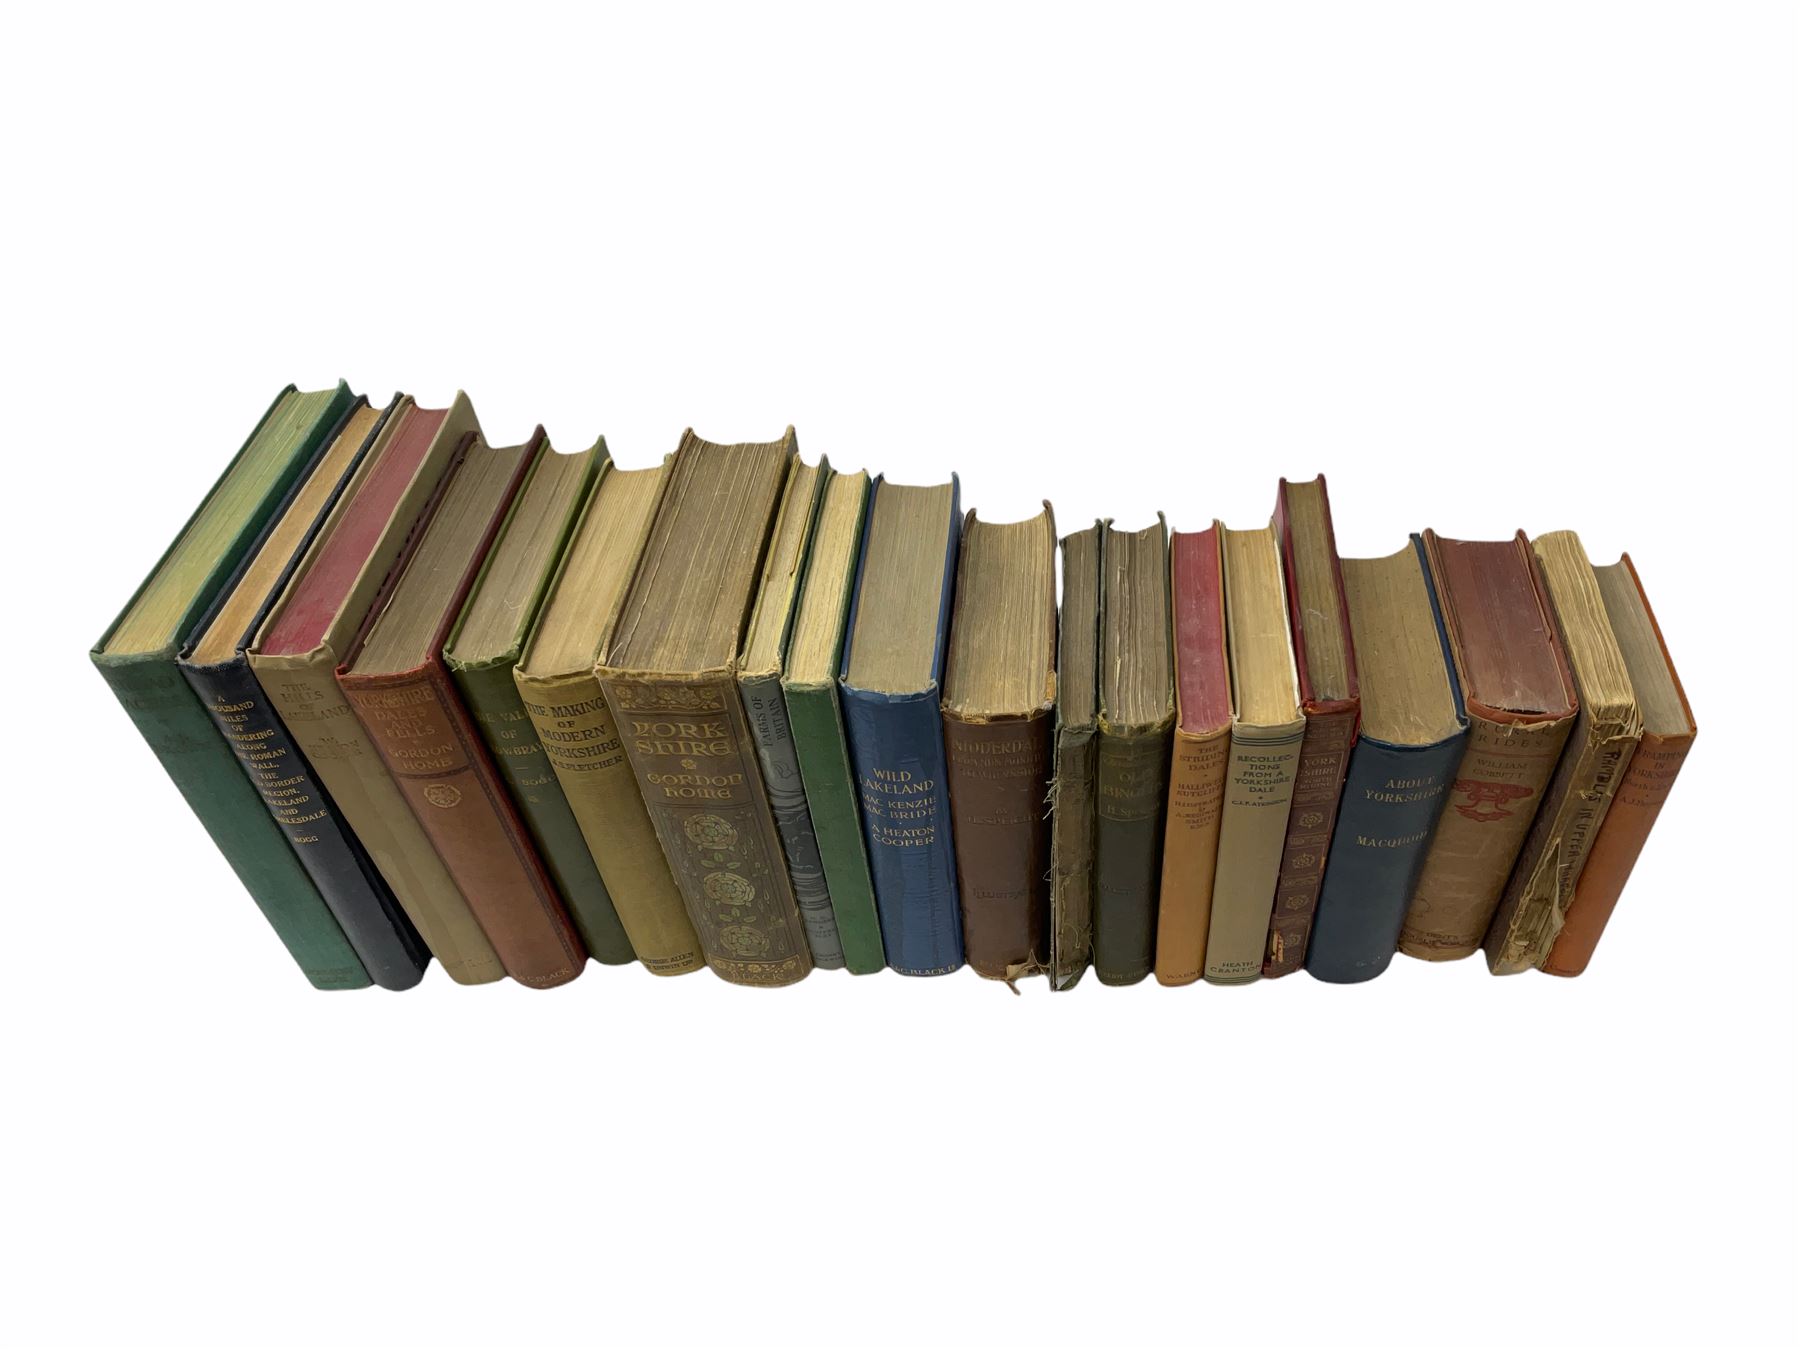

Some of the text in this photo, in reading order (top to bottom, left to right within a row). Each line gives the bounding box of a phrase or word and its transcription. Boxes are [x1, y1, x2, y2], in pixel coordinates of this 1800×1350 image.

[524, 696, 606, 718] THE MAKING
[751, 696, 764, 710] OF
[558, 720, 576, 728] OF
[768, 698, 787, 741] BRITAIN
[500, 730, 518, 740] OF
[540, 725, 607, 743] MODERN
[628, 722, 729, 738] YORK
[1478, 734, 1544, 748] RIDES
[388, 744, 454, 759] GORDON
[542, 738, 621, 759] YORKSHIRE
[634, 740, 736, 756] SHIRE
[402, 758, 454, 770] HOME
[1478, 758, 1528, 769] WILLIAM
[1654, 762, 1666, 770] IN
[648, 772, 743, 787] GORDON
[872, 767, 912, 782] WILD
[1234, 776, 1291, 786] YORKSHIRE
[264, 775, 305, 788] BORDER
[860, 774, 934, 795] LAKELAND
[1384, 776, 1436, 789] ABOUT
[664, 787, 733, 800] HOME
[888, 796, 937, 809] KENZIE
[890, 808, 936, 819] BRIDE
[1578, 808, 1594, 820] IN
[872, 824, 935, 837] A HEATON
[872, 834, 934, 848] COOPER
[1567, 823, 1589, 858] UPPER
[1210, 964, 1262, 974] CRANTON
